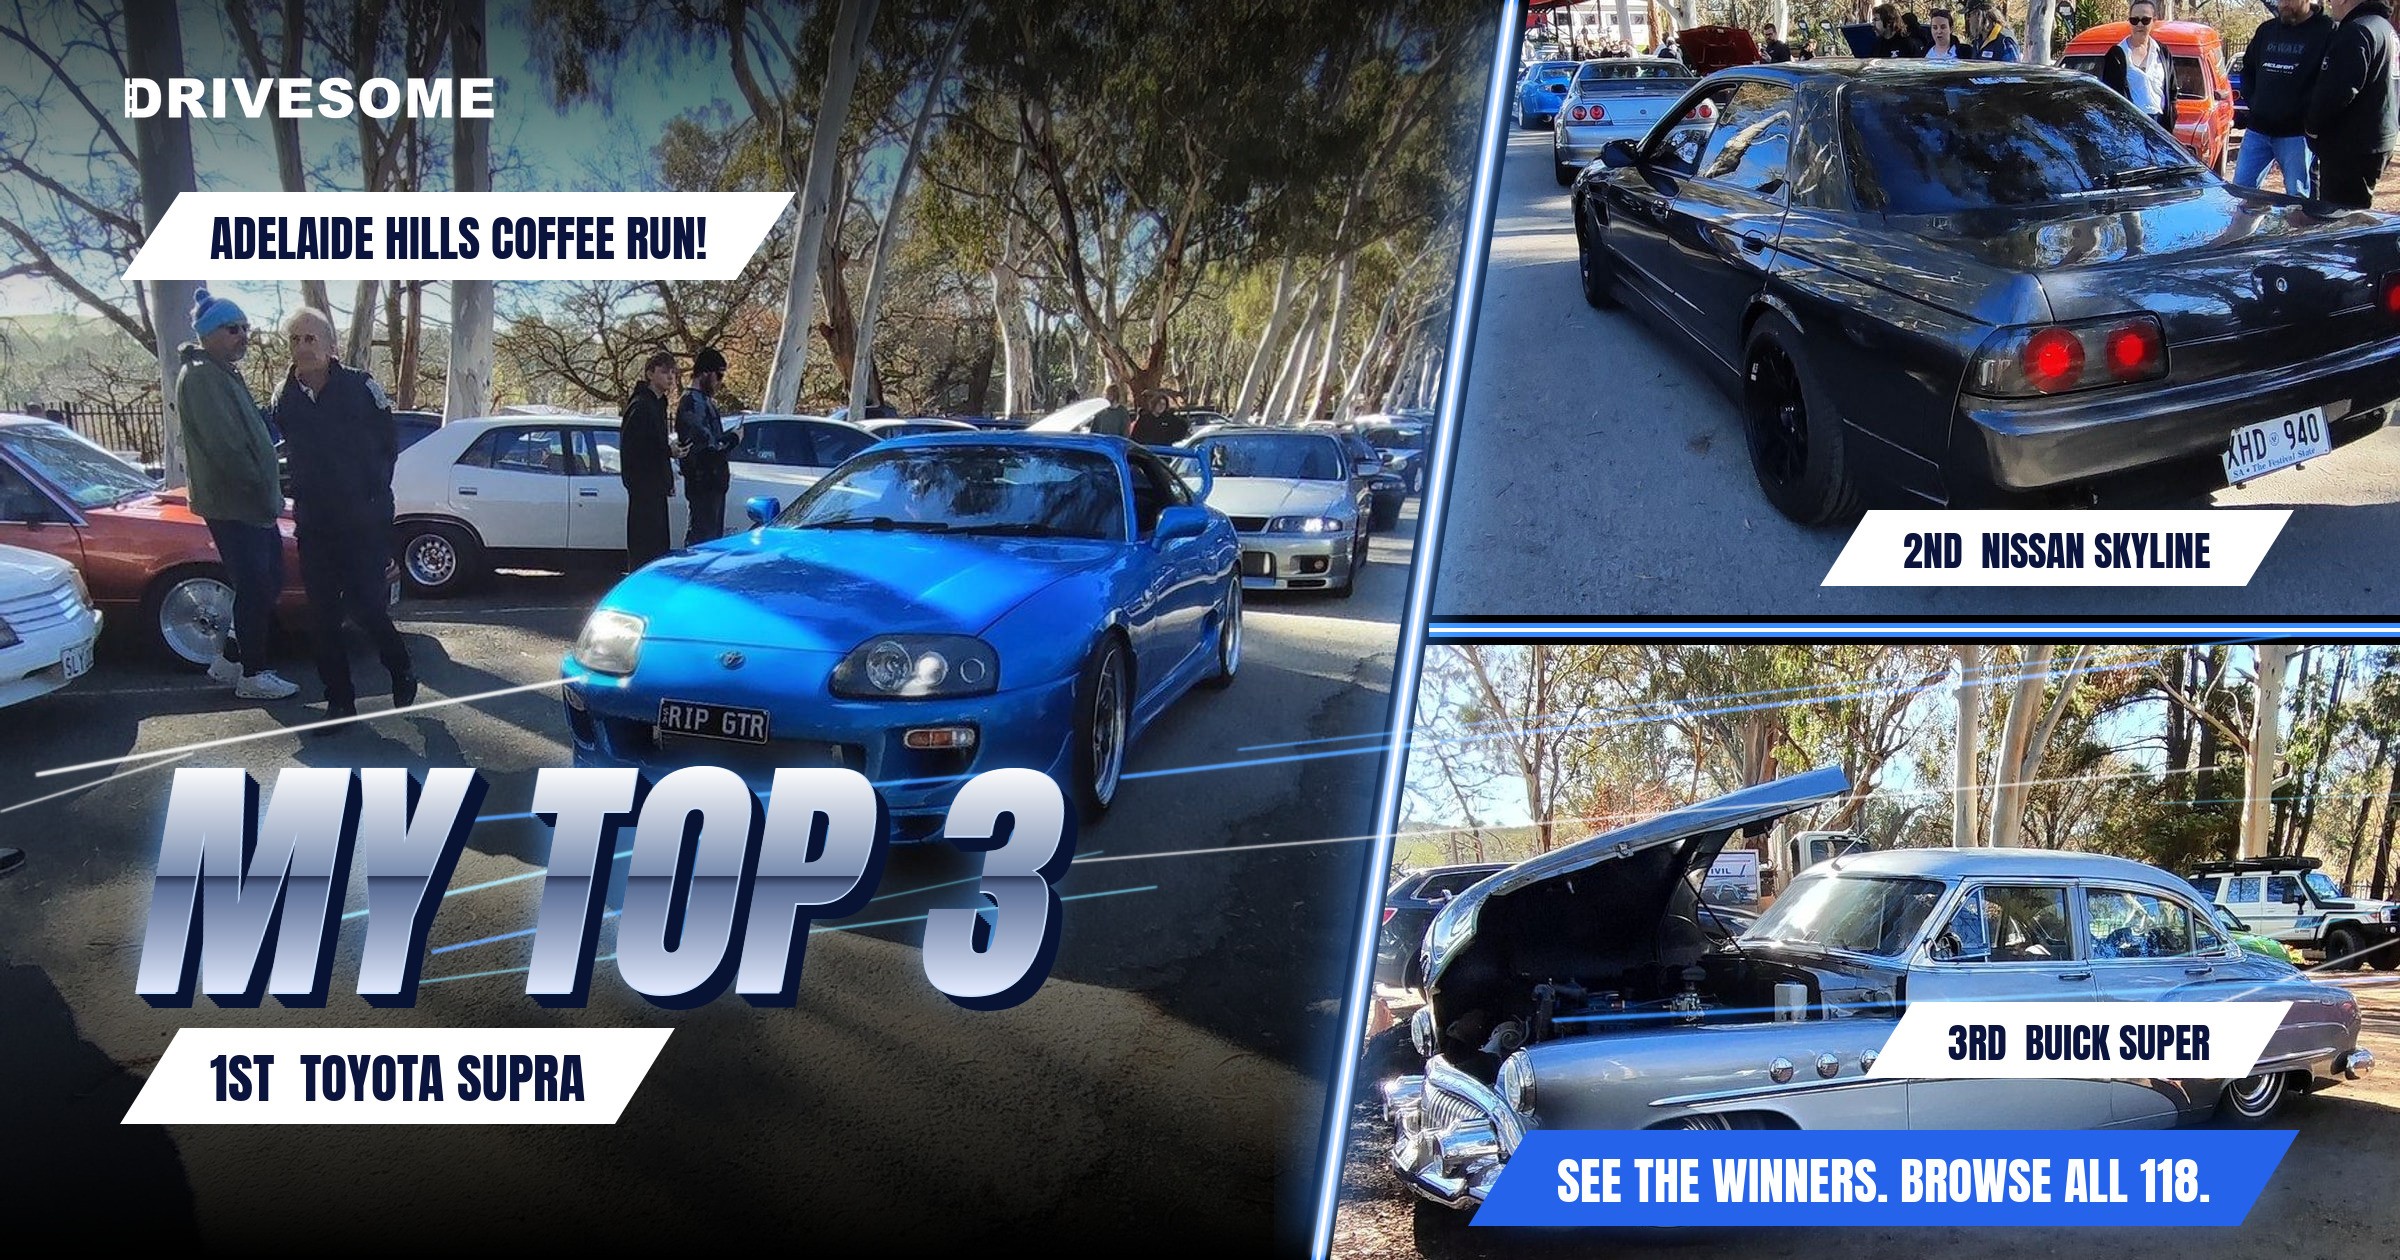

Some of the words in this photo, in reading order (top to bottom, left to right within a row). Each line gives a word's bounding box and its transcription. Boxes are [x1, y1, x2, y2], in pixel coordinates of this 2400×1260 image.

[2262, 62, 2295, 70] McLaren
[2228, 428, 2266, 470] XHD
[2284, 413, 2319, 450] 940
[2233, 470, 2244, 478] SA
[2252, 463, 2267, 473] The
[2268, 454, 2296, 468] Festival
[2297, 447, 2316, 459] State
[668, 705, 709, 731] RIP
[722, 711, 764, 739] GTR
